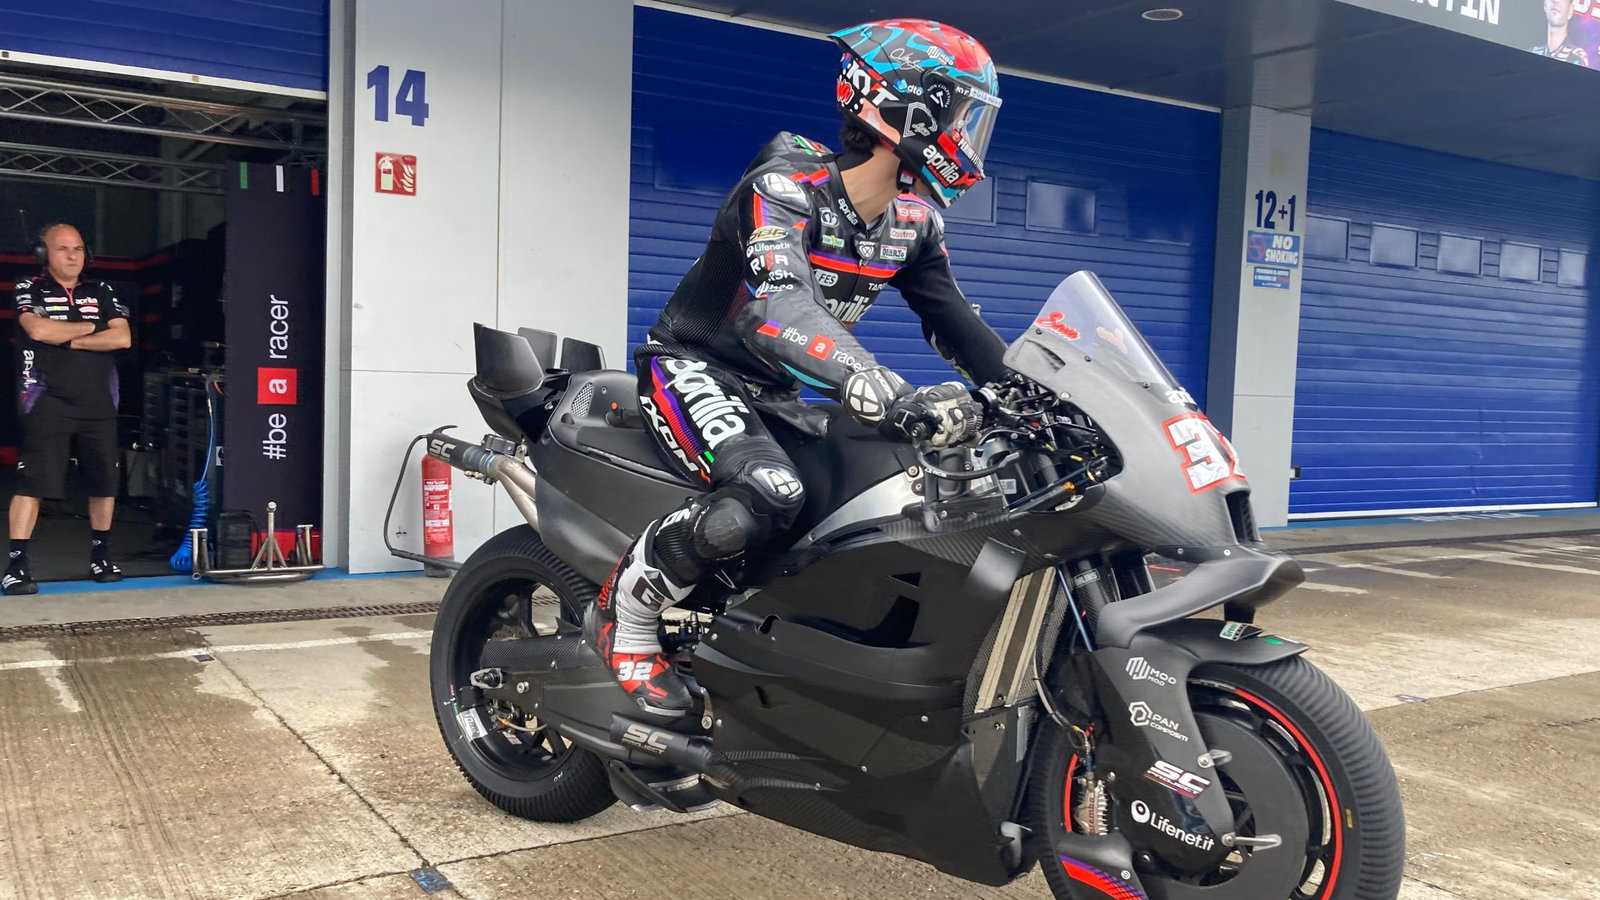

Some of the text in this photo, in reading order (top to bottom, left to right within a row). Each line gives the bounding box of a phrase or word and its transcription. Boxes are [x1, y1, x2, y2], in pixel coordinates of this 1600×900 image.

[367, 65, 429, 126] 14
[923, 144, 960, 184] aprilia
[838, 198, 858, 225] aprilia
[1255, 190, 1296, 232] 12+1
[1265, 249, 1298, 264] SMOKING
[1272, 235, 1293, 250] NO
[782, 326, 808, 346] #be
[815, 341, 826, 354] a
[263, 295, 289, 459] #be a racer
[665, 359, 750, 450] aprilia
[429, 439, 456, 458] SC
[1162, 413, 1246, 494] 3
[617, 661, 653, 681] 32
[623, 724, 674, 750] SC
[1152, 714, 1179, 730] PAN
[1150, 760, 1211, 793] SC
[1150, 812, 1215, 851] Lifenet.it
